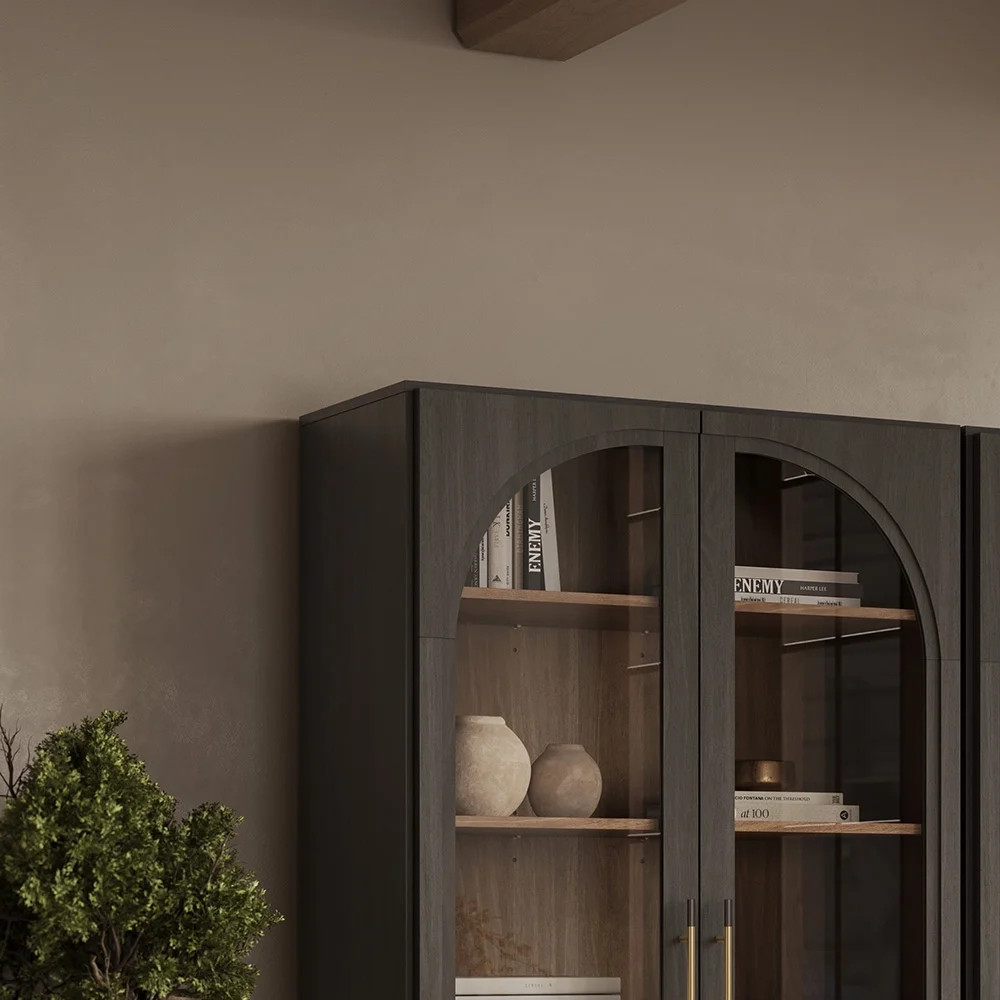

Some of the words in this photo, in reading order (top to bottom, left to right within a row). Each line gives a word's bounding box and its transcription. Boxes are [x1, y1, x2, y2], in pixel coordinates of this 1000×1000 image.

[528, 518, 542, 573] ENEMY
[734, 578, 784, 595] ENEMY
[740, 809, 750, 819] at
[752, 808, 770, 819] 100
